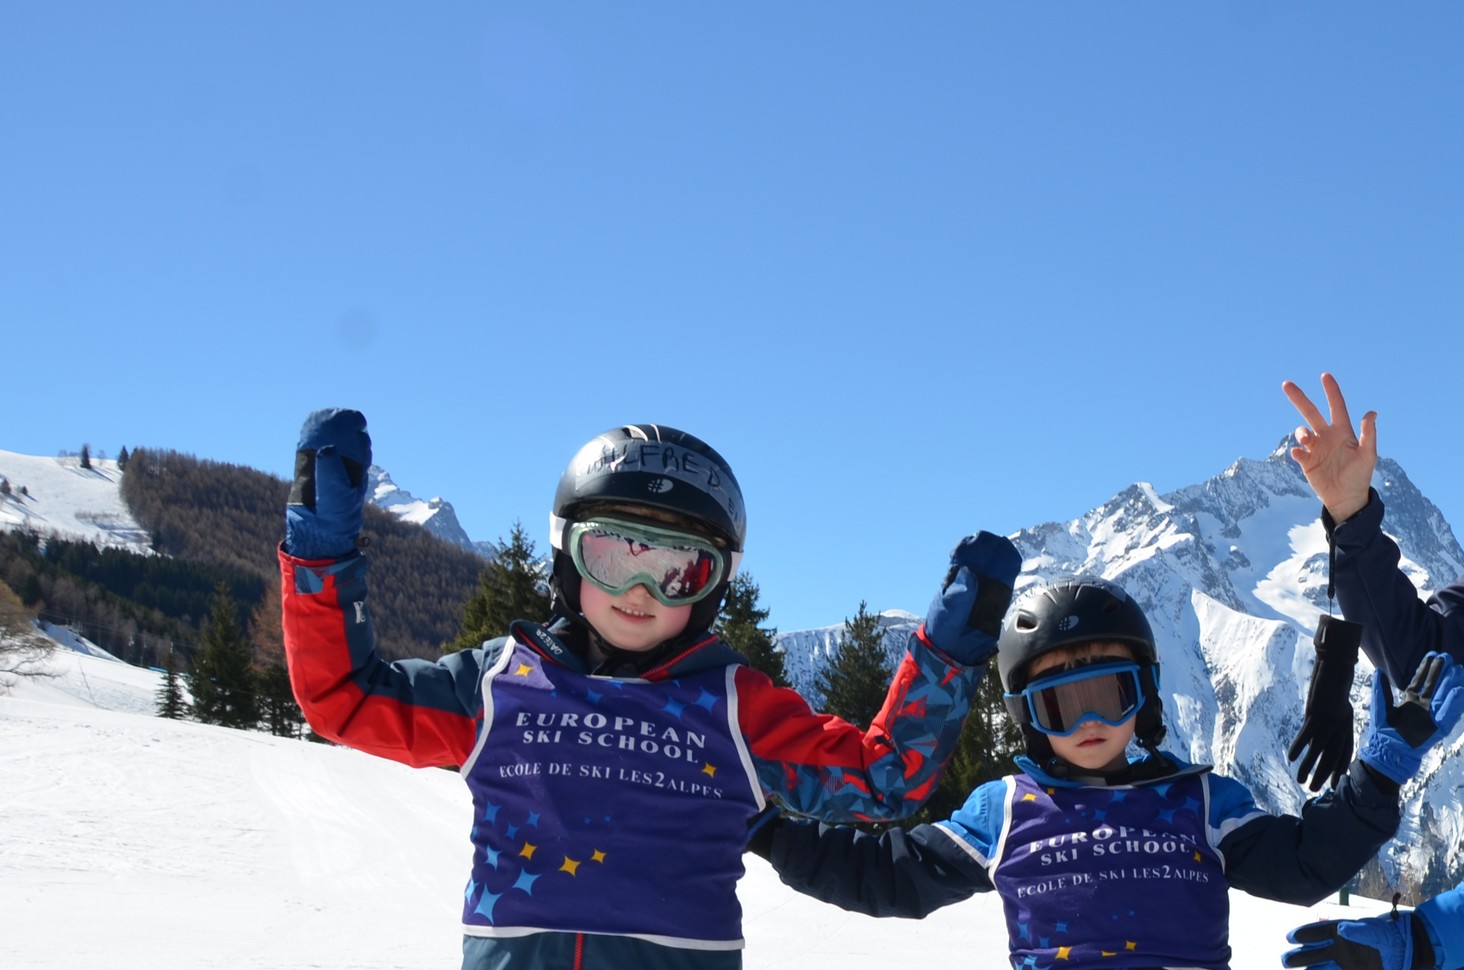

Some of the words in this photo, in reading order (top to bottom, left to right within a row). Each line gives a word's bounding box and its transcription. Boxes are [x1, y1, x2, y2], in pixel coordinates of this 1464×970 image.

[515, 711, 706, 749] EUROPEAN
[522, 730, 562, 744] SKI
[577, 731, 699, 763] SCHOOL
[499, 762, 542, 778] ECOLE
[548, 763, 572, 776] DE
[579, 765, 611, 779] SKI
[1040, 848, 1078, 866] SKI
[1092, 840, 1190, 857] SCHOOL
[1017, 877, 1067, 899] ECOLE
[1072, 873, 1093, 886] DE
[1099, 869, 1126, 880] SKI
